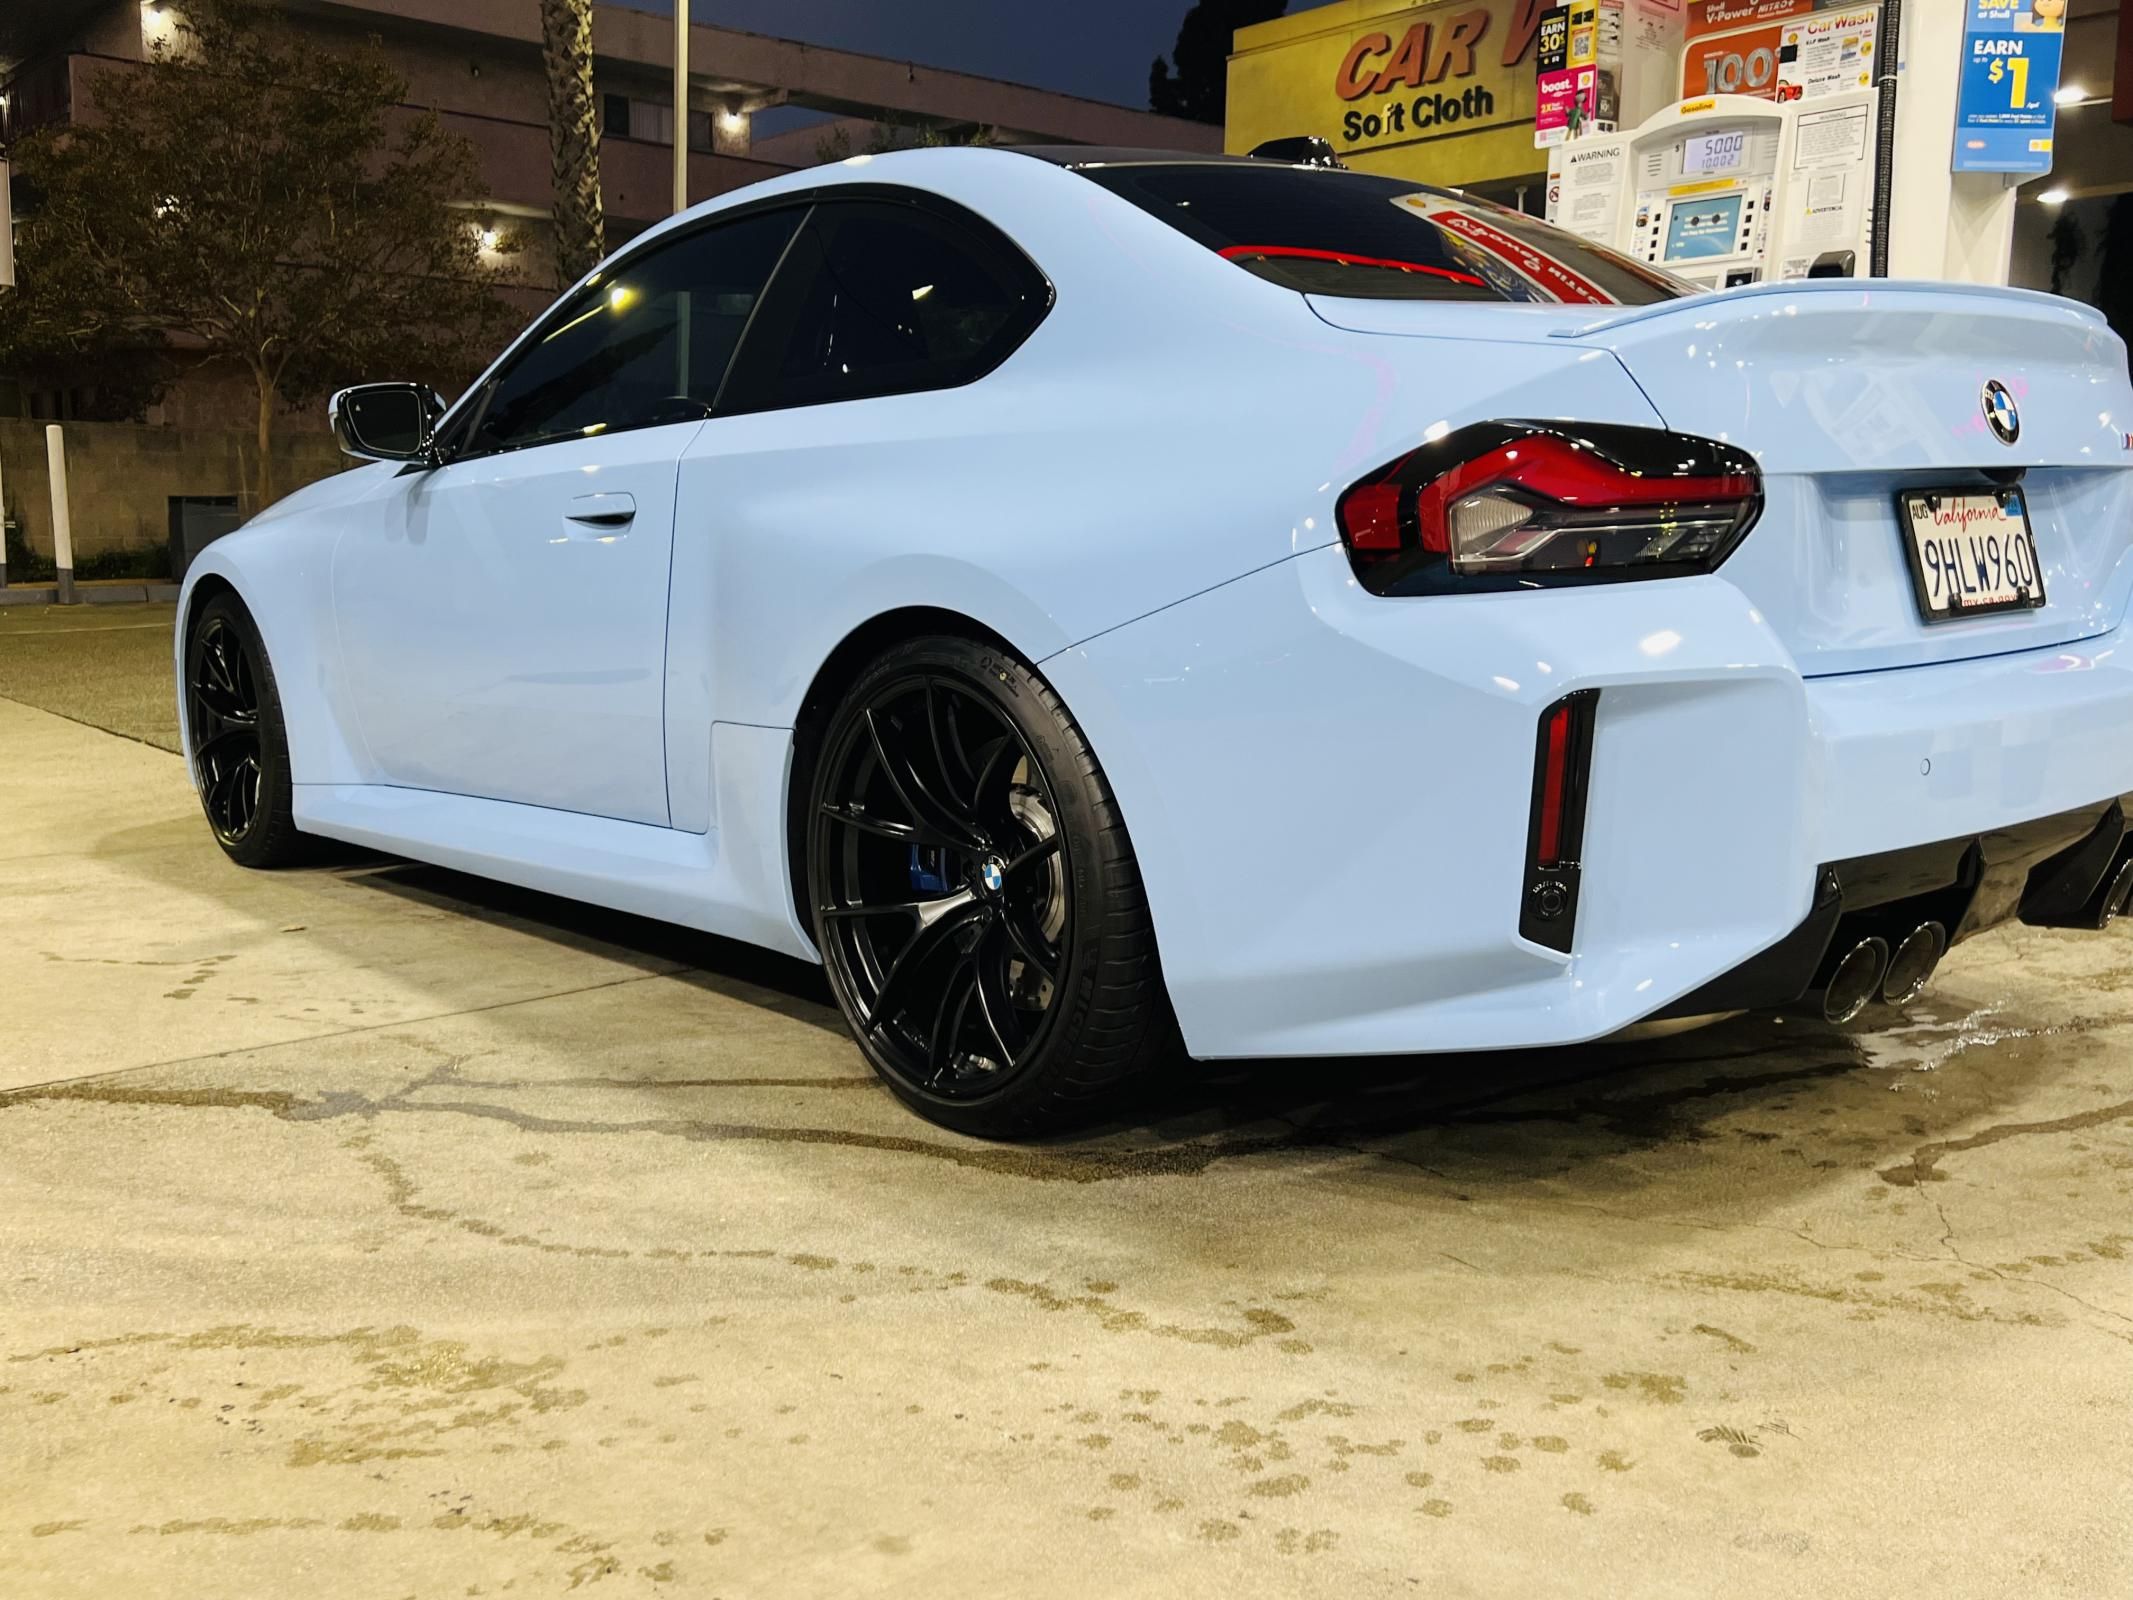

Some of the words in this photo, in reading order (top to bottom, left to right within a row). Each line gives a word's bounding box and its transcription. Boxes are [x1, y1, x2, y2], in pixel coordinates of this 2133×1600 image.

[1706, 2, 1726, 13] Shell
[1706, 7, 1754, 24] V-Power
[1540, 22, 1566, 36] EARN
[1807, 20, 1831, 34] Car
[1835, 10, 1874, 29] Wash
[1335, 9, 1490, 101] CAR
[1973, 39, 2023, 55] EARN
[1703, 46, 1780, 95] 100
[1343, 102, 1406, 141] Soft
[1411, 85, 1494, 128] Cloth
[1681, 102, 1713, 114] Gasoline
[1577, 147, 1620, 162] WARNING
[1912, 504, 1928, 520] AUG
[1934, 497, 2007, 533] California
[1924, 533, 2034, 597] 9HLW960
